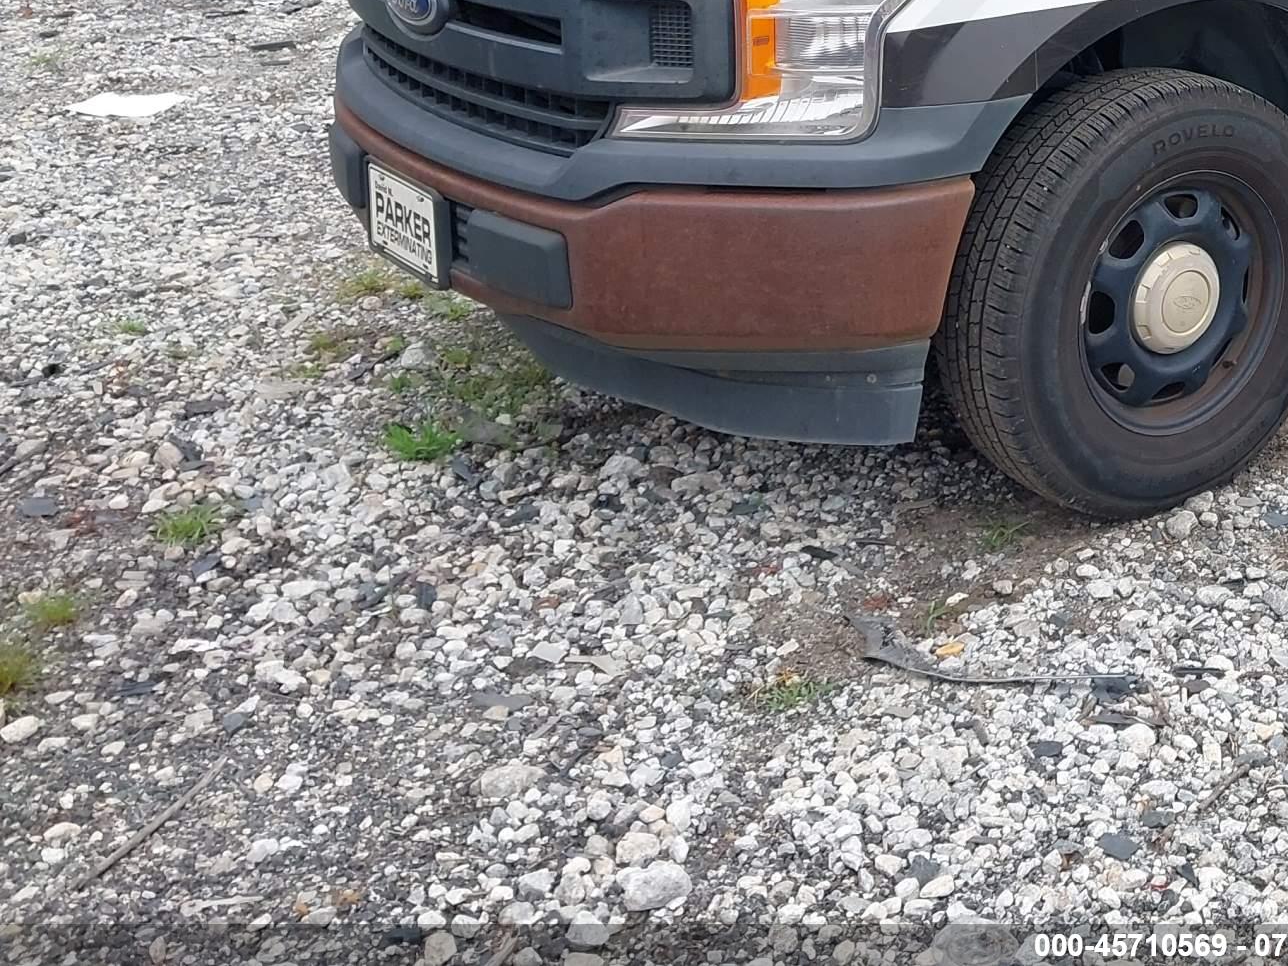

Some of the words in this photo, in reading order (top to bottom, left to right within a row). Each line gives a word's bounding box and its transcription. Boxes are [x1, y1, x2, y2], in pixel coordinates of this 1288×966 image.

[1153, 124, 1235, 155] ROVELO
[375, 190, 432, 248] PARKER
[376, 220, 433, 265] EXTERMINATING
